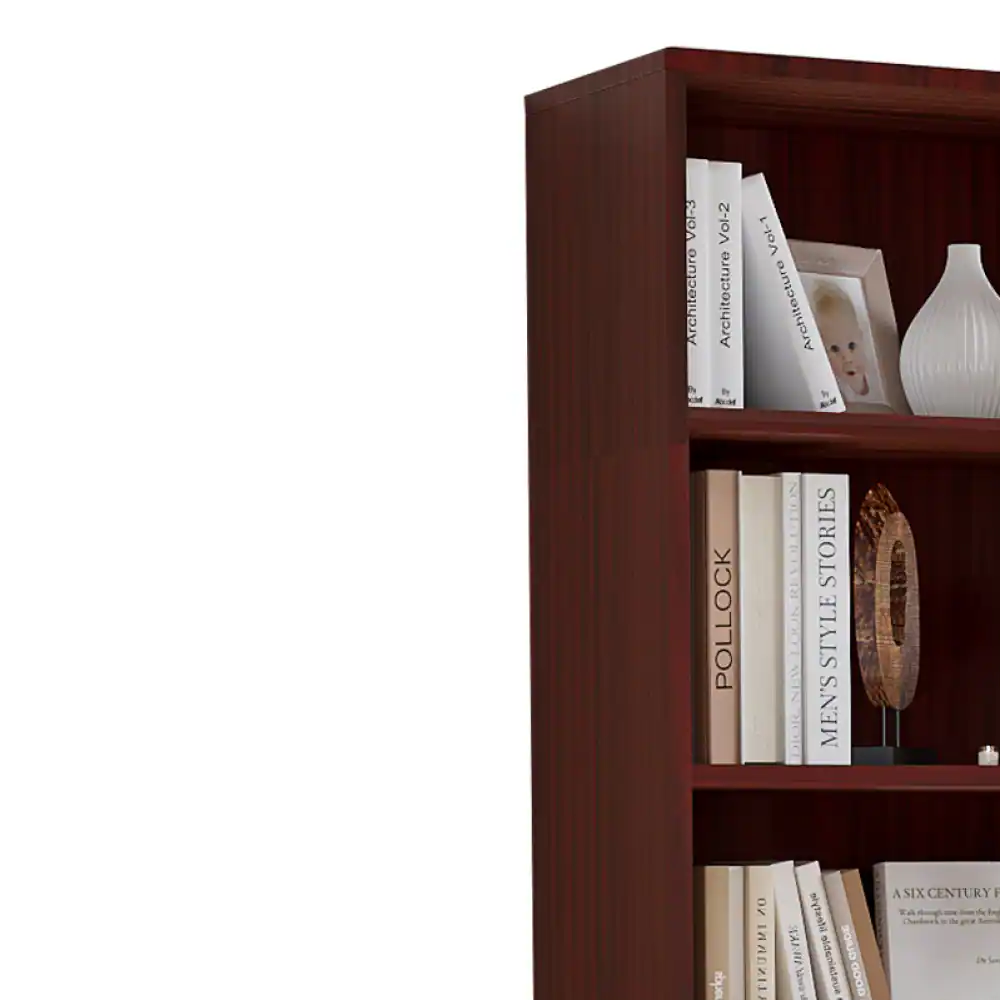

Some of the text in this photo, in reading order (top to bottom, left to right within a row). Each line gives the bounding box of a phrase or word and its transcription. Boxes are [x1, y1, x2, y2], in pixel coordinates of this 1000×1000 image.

[686, 199, 698, 346] Architecture Vol-3
[719, 202, 731, 348] Architecture Vol-2
[760, 216, 815, 351] Architecture Vol-1
[714, 548, 733, 690] POLLOCK
[818, 487, 839, 748] MEN'S STYLE STORIES
[892, 887, 901, 899] A
[903, 887, 925, 899] SIX
[927, 887, 991, 899] CENTURY
